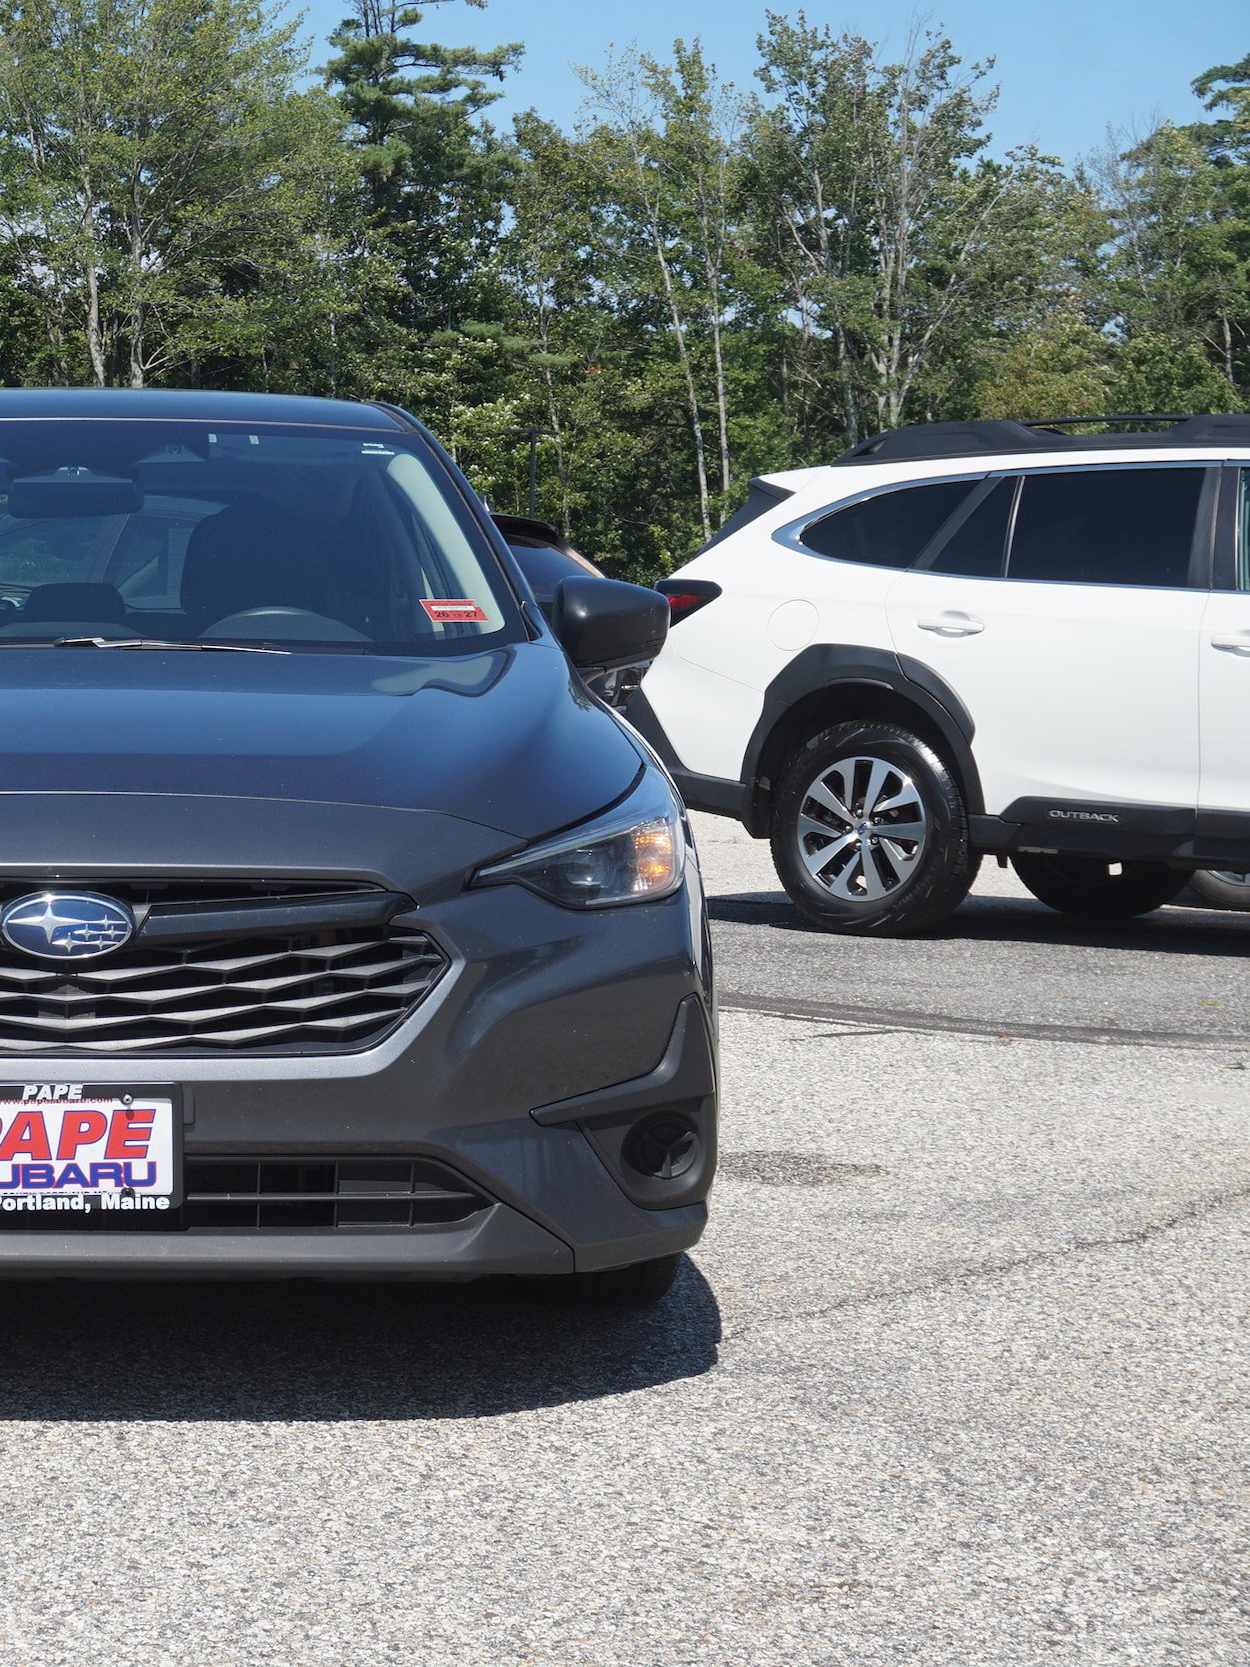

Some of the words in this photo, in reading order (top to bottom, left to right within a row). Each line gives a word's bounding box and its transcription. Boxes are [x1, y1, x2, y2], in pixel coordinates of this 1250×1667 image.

[1049, 809, 1119, 823] OUTBACK
[22, 1083, 84, 1100] PAPE
[101, 1193, 170, 1211] Maine
